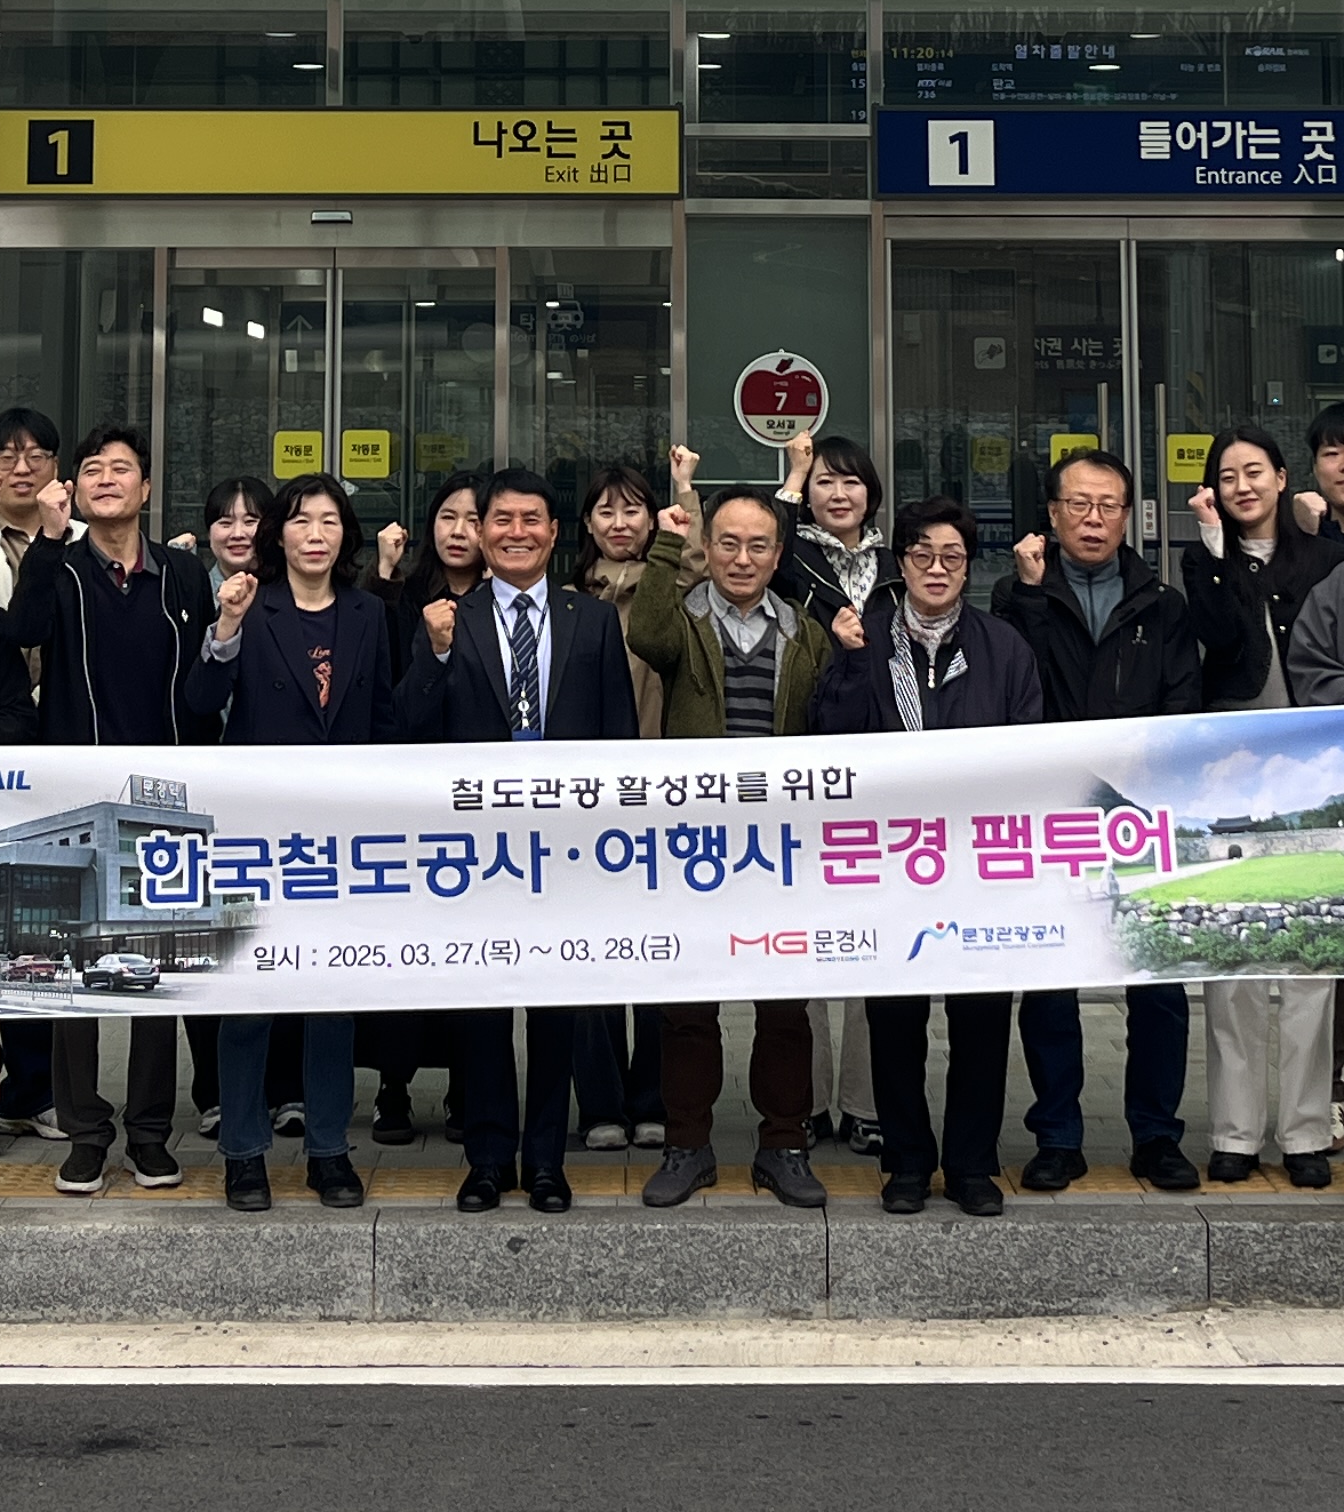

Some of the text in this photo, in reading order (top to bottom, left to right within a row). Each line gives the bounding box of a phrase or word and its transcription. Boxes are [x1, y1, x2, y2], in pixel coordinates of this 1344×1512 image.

[47, 131, 69, 175] 1
[472, 120, 633, 160] 나오는 곳
[948, 130, 969, 176] 1
[1138, 120, 1336, 161] 들어가는 곳
[544, 163, 633, 184] Exit 出口
[1196, 163, 1338, 185] Entrance 入口
[774, 391, 788, 411] 7
[284, 445, 313, 456] 자동문
[351, 444, 380, 455] 자동문
[452, 765, 857, 811] 철도관광 활성화를 위한
[819, 816, 950, 886] 문경
[970, 809, 1173, 881] 팸투어
[730, 928, 878, 955] MG 문경시
[962, 924, 1065, 943] 문경관광공사
[254, 945, 301, 971] 일시
[327, 944, 393, 969] 2025.
[400, 943, 436, 967] 03.
[445, 937, 522, 967] 27.(목)
[560, 939, 596, 963] 03.
[604, 933, 682, 963] 28.(금)
